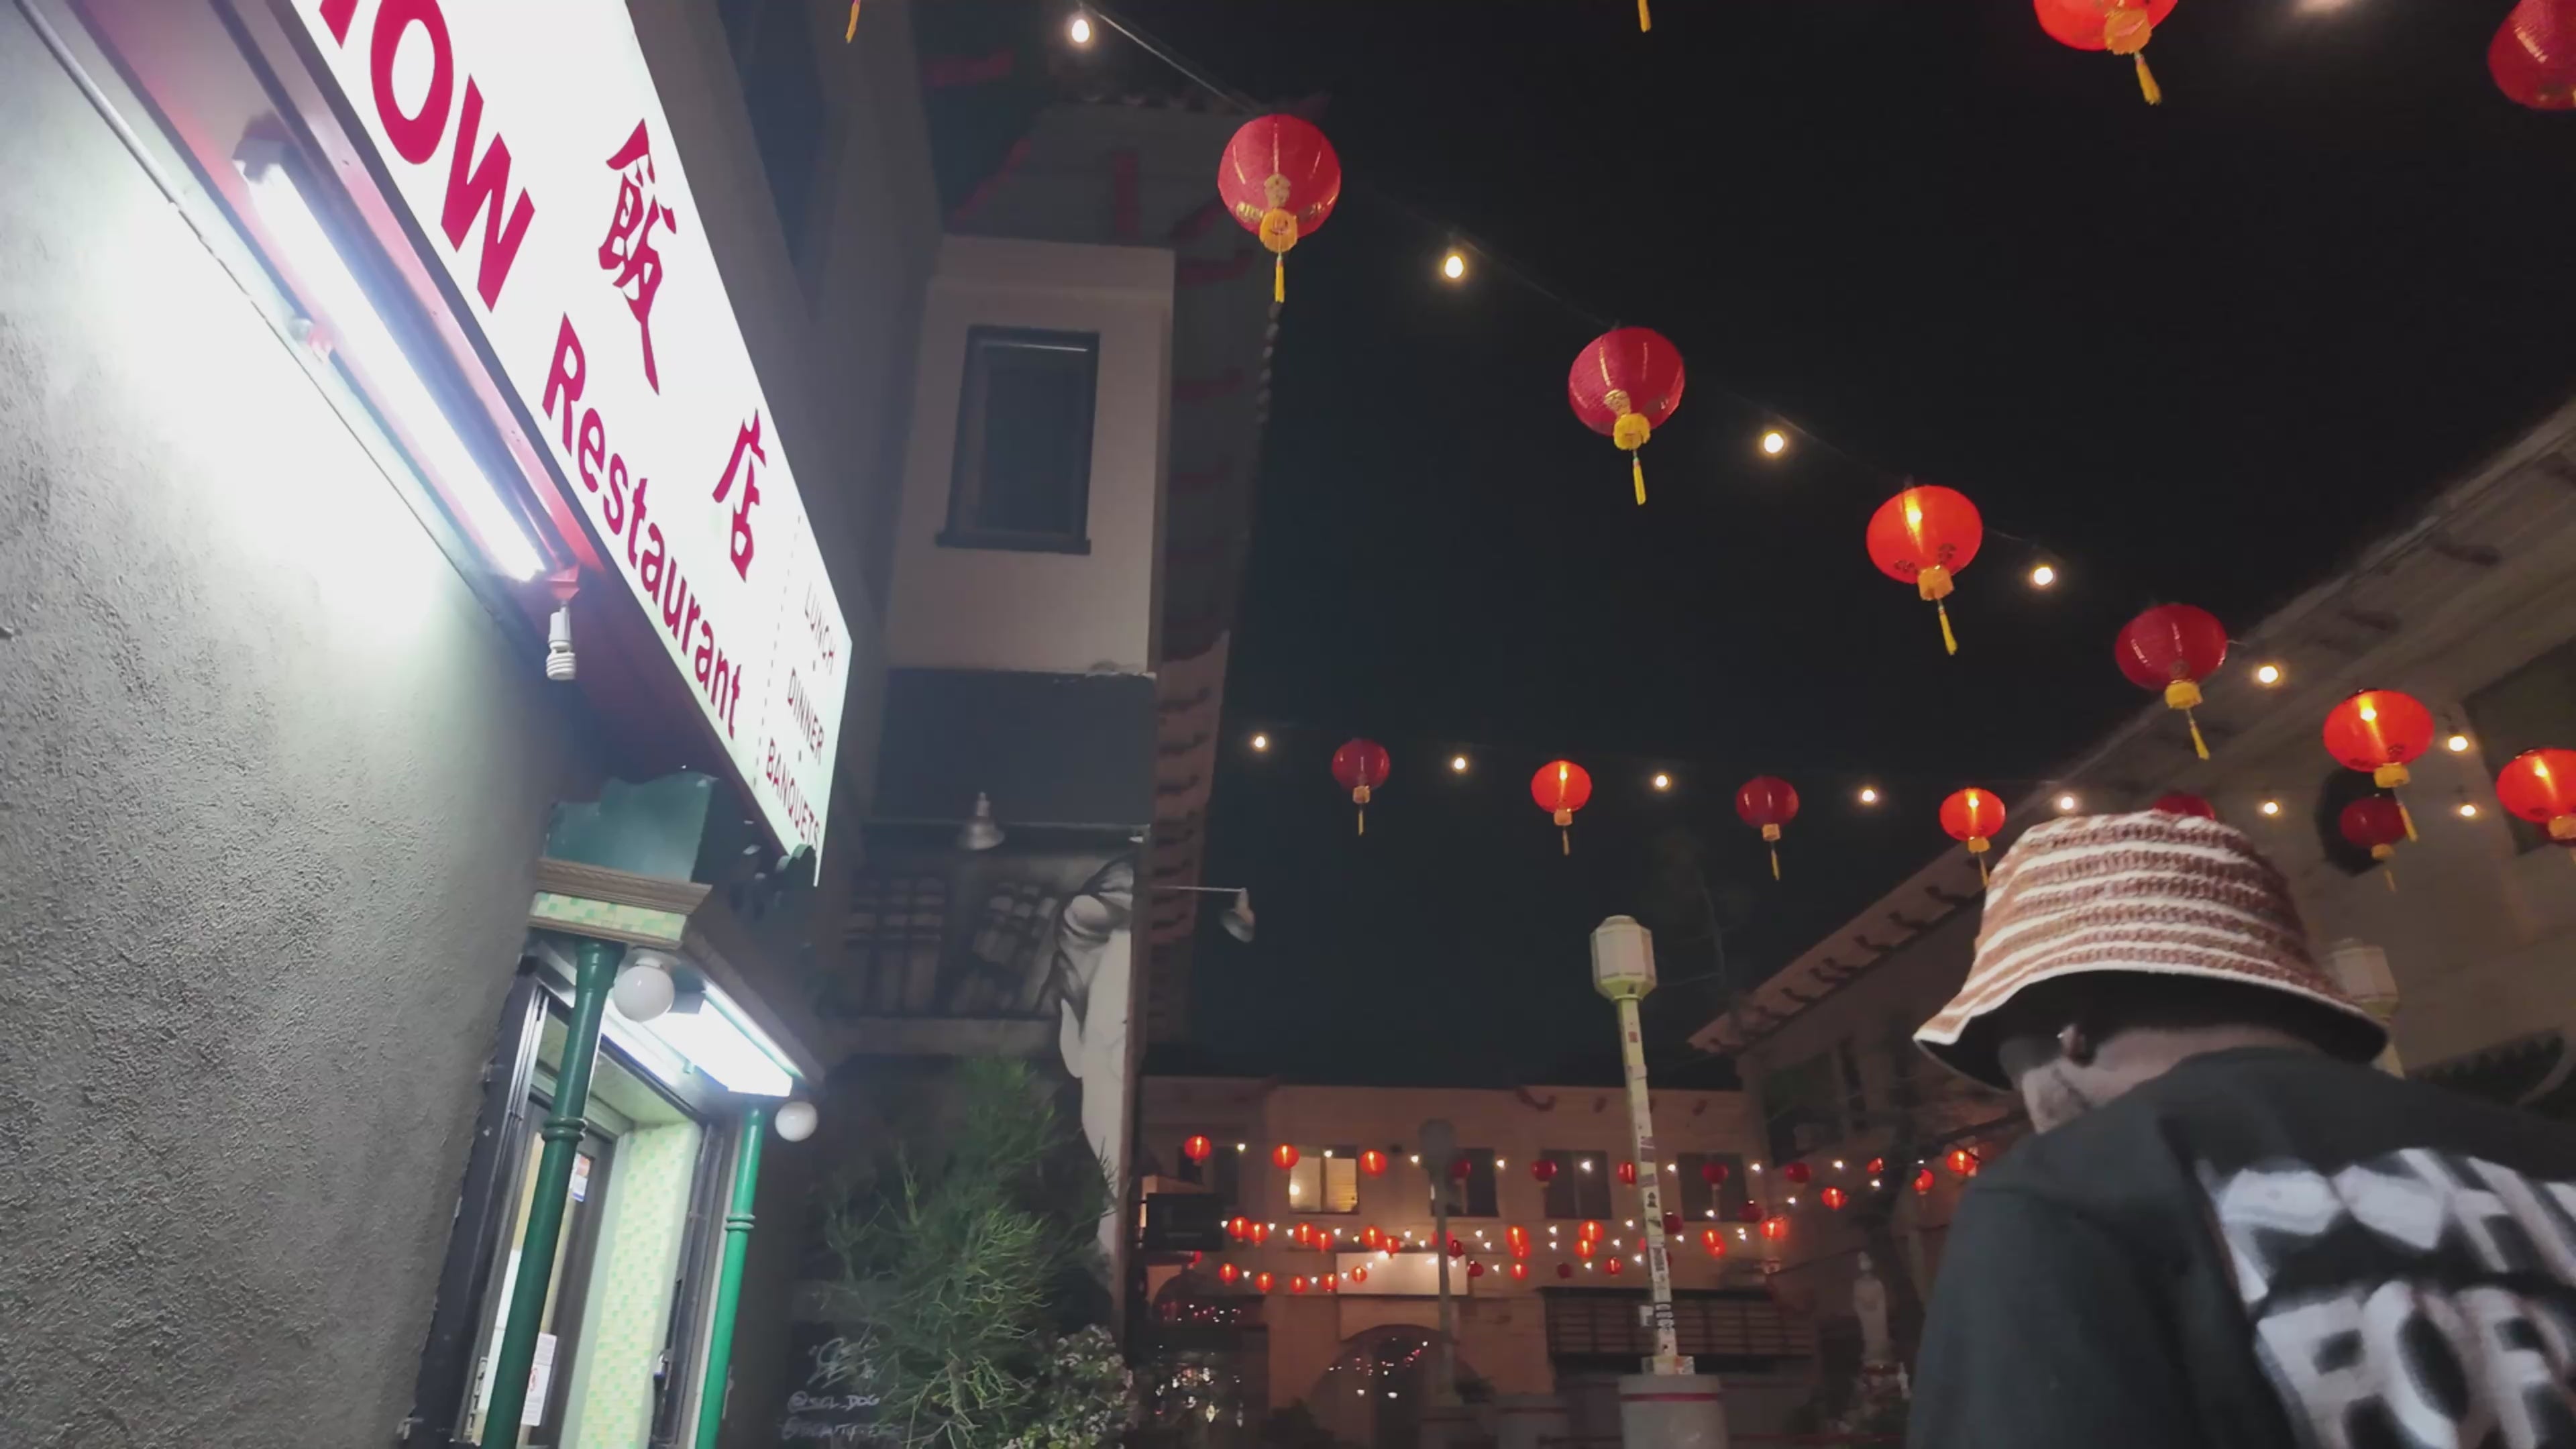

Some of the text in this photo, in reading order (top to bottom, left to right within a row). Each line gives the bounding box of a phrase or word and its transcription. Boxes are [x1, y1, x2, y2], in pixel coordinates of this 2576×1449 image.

[319, 0, 535, 314] OW
[542, 313, 741, 741] Restaurant
[804, 582, 836, 675] LUNCH
[787, 665, 824, 766] DINNER
[766, 735, 820, 856] BANQUETS
